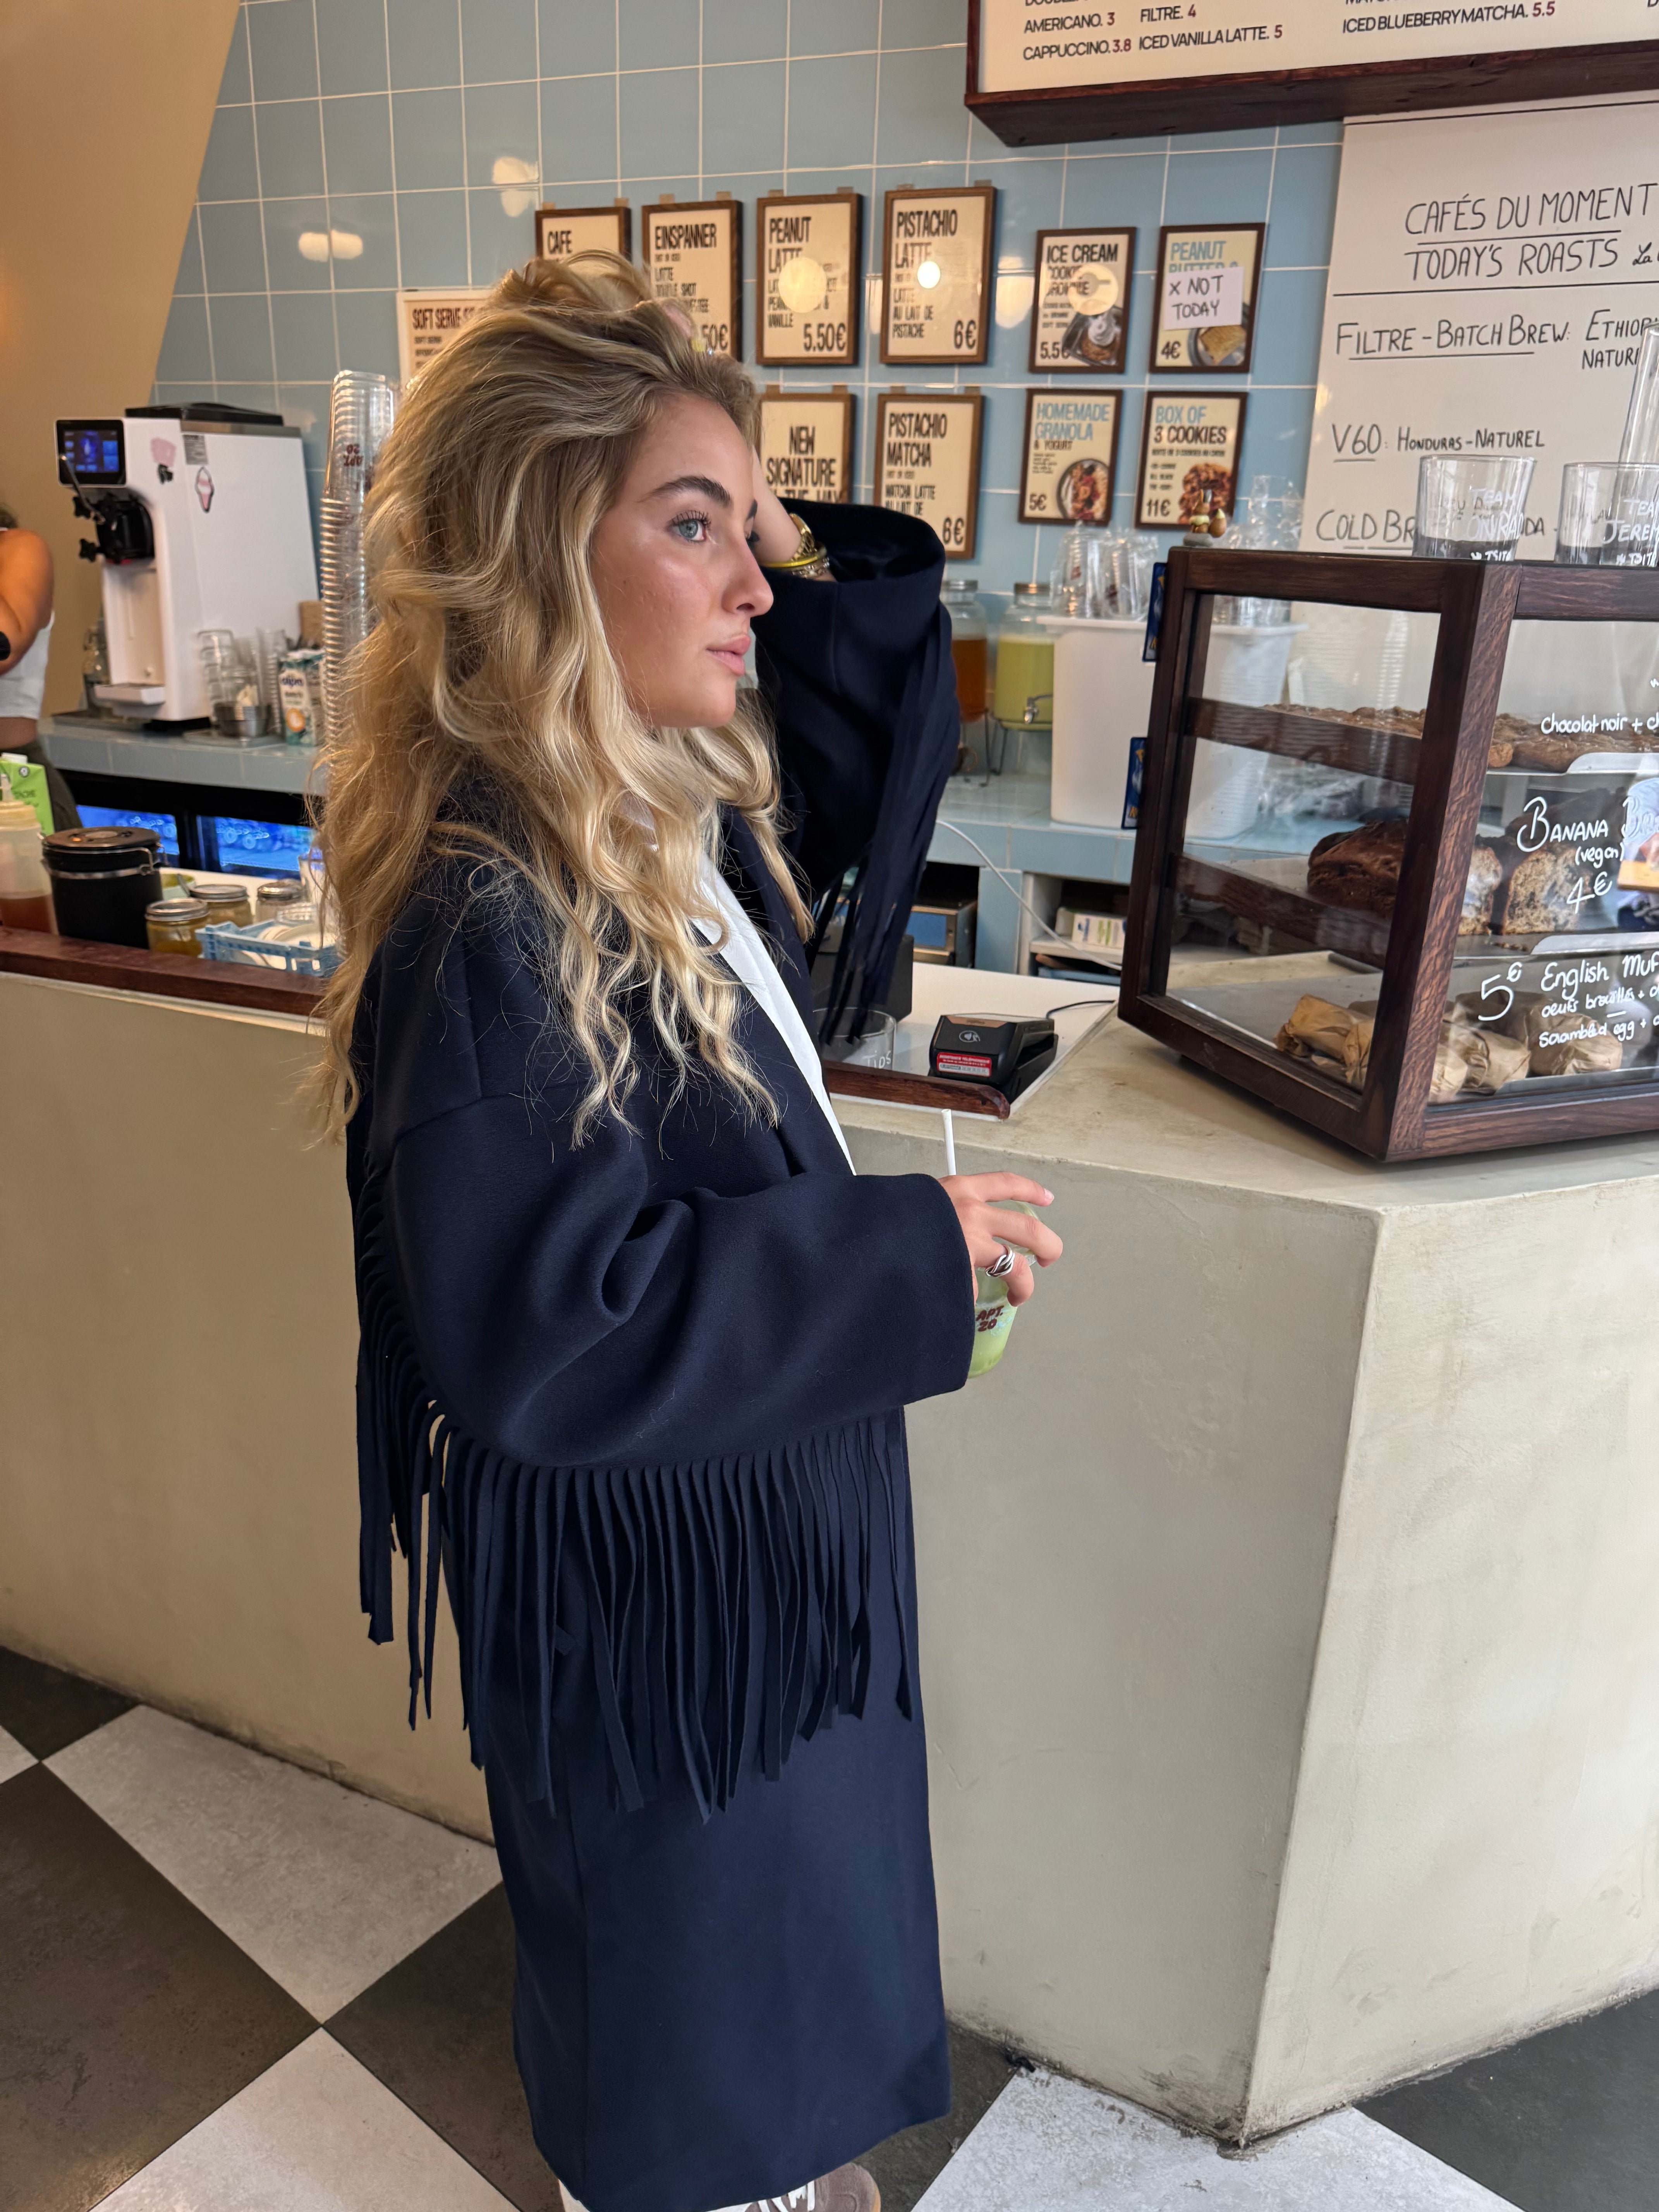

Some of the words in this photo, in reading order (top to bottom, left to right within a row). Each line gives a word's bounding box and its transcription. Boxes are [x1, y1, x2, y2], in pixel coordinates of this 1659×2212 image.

[1024, 13, 1103, 34] AMERICANO.
[1107, 12, 1115, 26] 3
[1140, 7, 1183, 22] FILTRE.
[1188, 4, 1197, 18] 4
[1343, 17, 1376, 33] ICED
[1378, 9, 1464, 30] BLUEBERRY
[1461, 4, 1528, 23] MATCHA.
[1532, 2, 1555, 18] 5.5
[1139, 34, 1169, 50] ICED
[1170, 29, 1223, 47] VANILLA
[1225, 26, 1269, 43] LATTE.
[1274, 24, 1283, 38] 5
[1023, 40, 1111, 60] CAPPUCCINO.
[1113, 38, 1131, 53] 3.8
[1405, 193, 1486, 235] CAFÉS
[1497, 195, 1530, 230] DU
[1539, 183, 1659, 226] MOMENT
[769, 216, 812, 244] PEANUT
[896, 210, 958, 238] PISTACHIO
[1047, 245, 1068, 263] ICE
[1072, 244, 1118, 263] CREAM
[1170, 241, 1226, 261] PEANUT
[1405, 244, 1503, 281] TODAY'S
[1518, 239, 1618, 276] ROASTS
[1187, 275, 1224, 295] NOT
[1172, 300, 1220, 321] TODAY
[804, 323, 846, 352] 5.50€
[953, 319, 976, 349] 6€
[1336, 322, 1416, 355] FILTRE
[1437, 319, 1503, 349] BATCH
[1585, 309, 1658, 340] ETHIOP
[1161, 340, 1181, 360] 4€
[1036, 403, 1111, 422] HOMEMADE
[1155, 405, 1183, 424] BOX
[1187, 406, 1207, 424] OF
[889, 412, 948, 439] PISTACHIO
[1034, 422, 1093, 441] GRANOLA
[1154, 426, 1163, 443] 3
[1167, 426, 1227, 444] COOKIES
[1475, 428, 1545, 448] NATUREL
[886, 442, 932, 468] MATCHA
[766, 457, 836, 487] SIGNATURE
[1029, 493, 1047, 512] 5€
[1147, 498, 1171, 517] 11€
[942, 517, 964, 546] 6€
[1316, 510, 1377, 541] COLD
[1601, 713, 1628, 732] noir
[1517, 796, 1608, 852] BANANA
[1540, 959, 1609, 1000] English
[1613, 1020, 1635, 1042] egg
[975, 1305, 1005, 1322] APT.
[978, 1318, 997, 1332] 20
